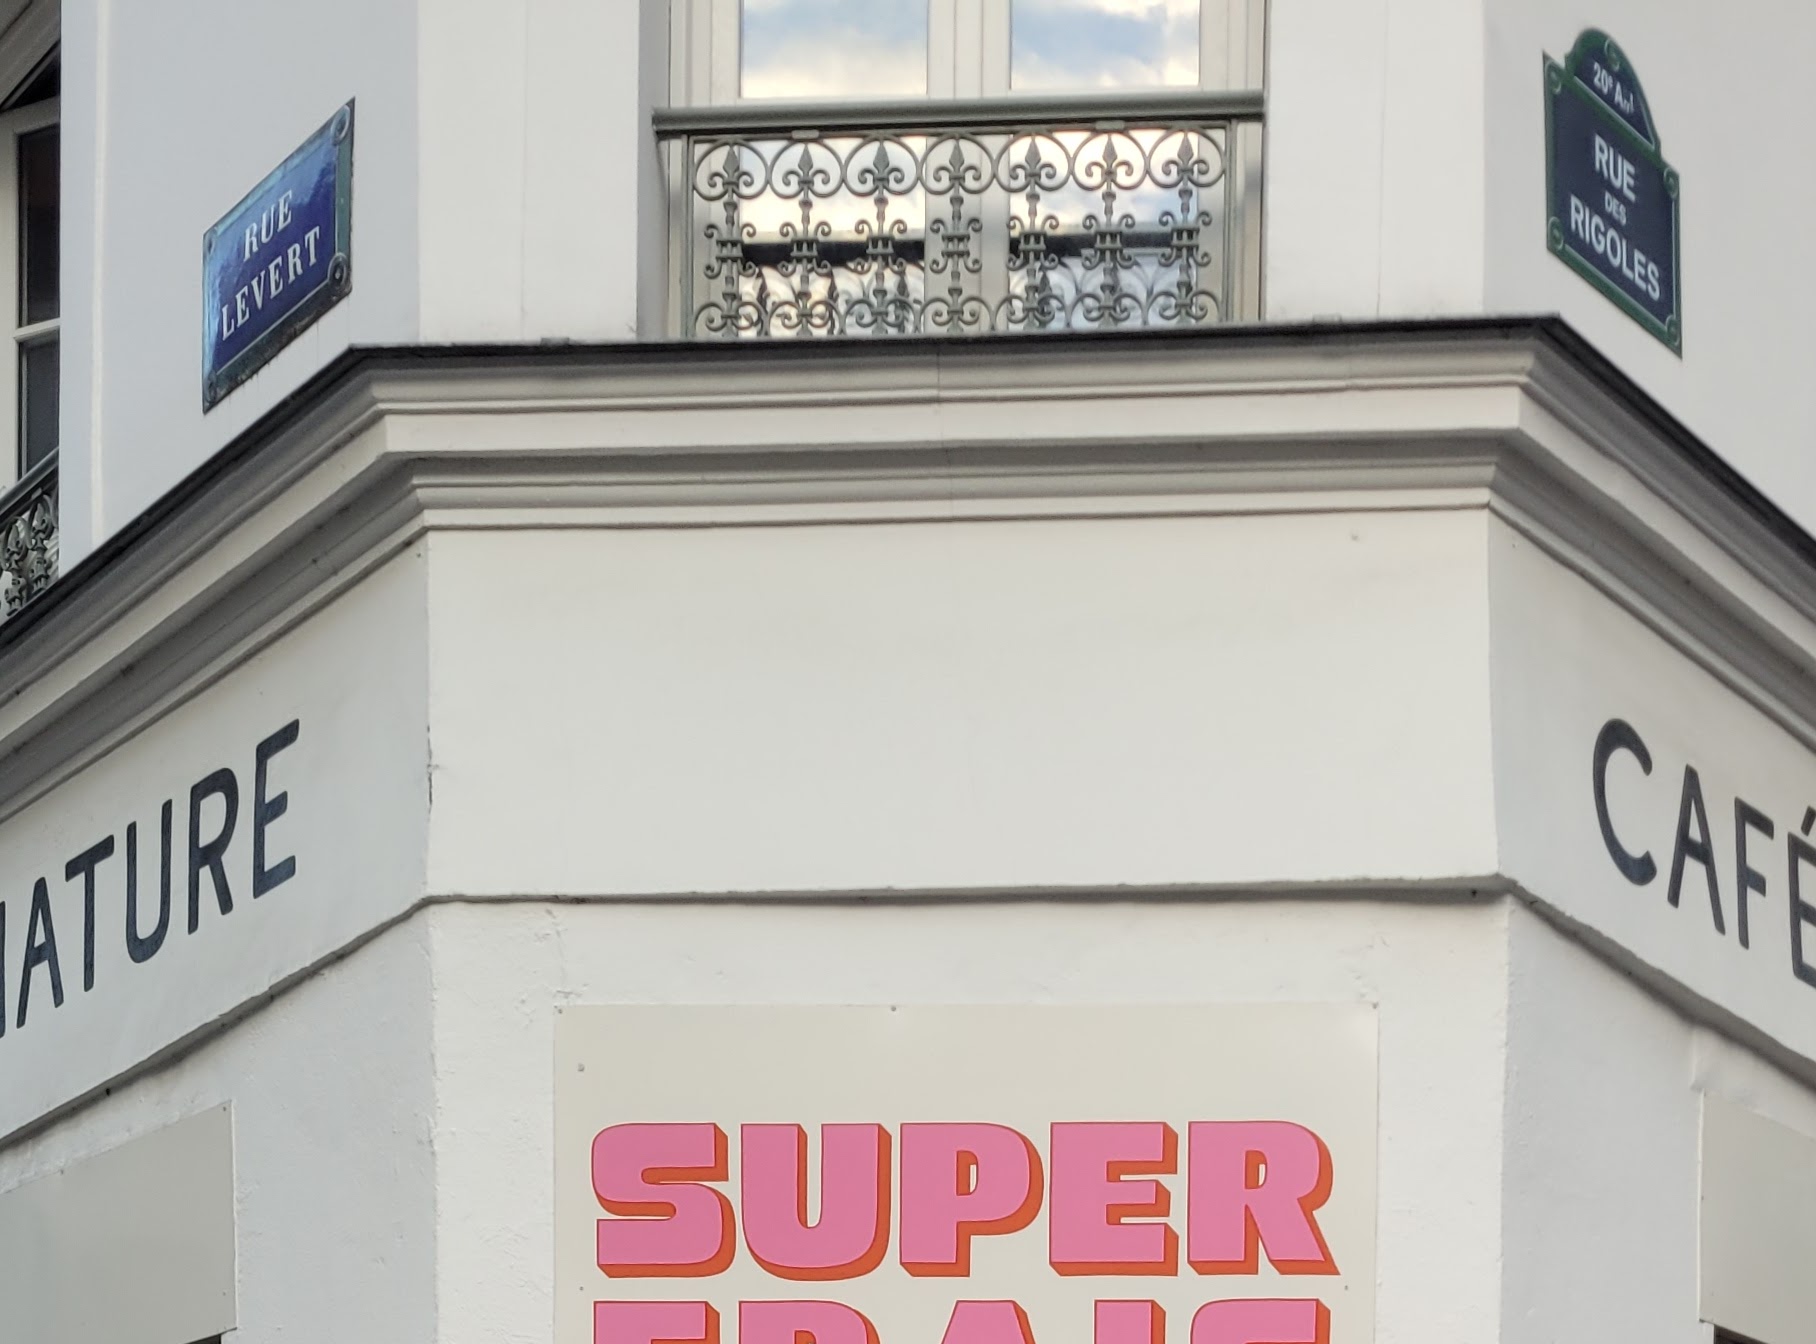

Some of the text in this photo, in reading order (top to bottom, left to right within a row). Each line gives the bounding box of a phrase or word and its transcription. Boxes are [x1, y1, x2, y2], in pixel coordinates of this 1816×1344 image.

[1595, 134, 1636, 202] RUE
[1605, 190, 1627, 226] DES
[243, 189, 294, 263] RUE
[1570, 194, 1661, 301] RIGOLES
[221, 226, 320, 341] LEVERT
[0, 718, 300, 1038] ATURE
[591, 1121, 1341, 1281] SUPER
